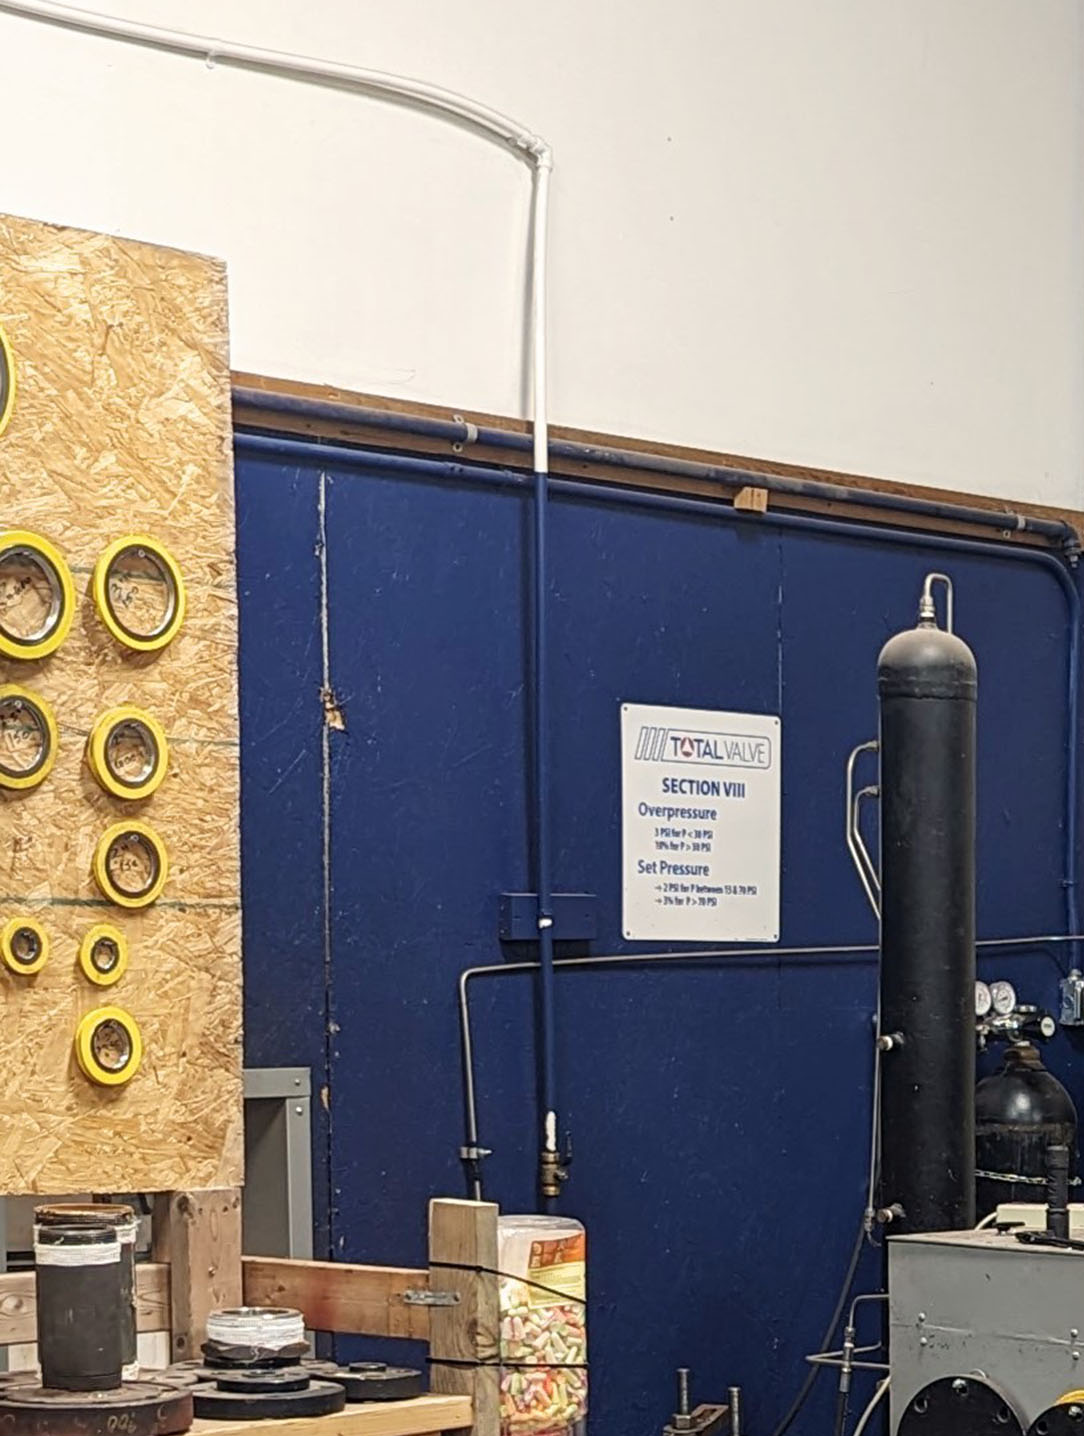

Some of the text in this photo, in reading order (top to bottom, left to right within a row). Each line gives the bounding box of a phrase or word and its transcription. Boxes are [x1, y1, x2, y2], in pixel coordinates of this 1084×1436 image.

[670, 736, 765, 764] TOTAL VALVE
[662, 777, 746, 798] SECTION VIII
[638, 802, 718, 822] Overpressure
[638, 859, 710, 877] Set Pressure
[668, 882, 679, 893] PSI
